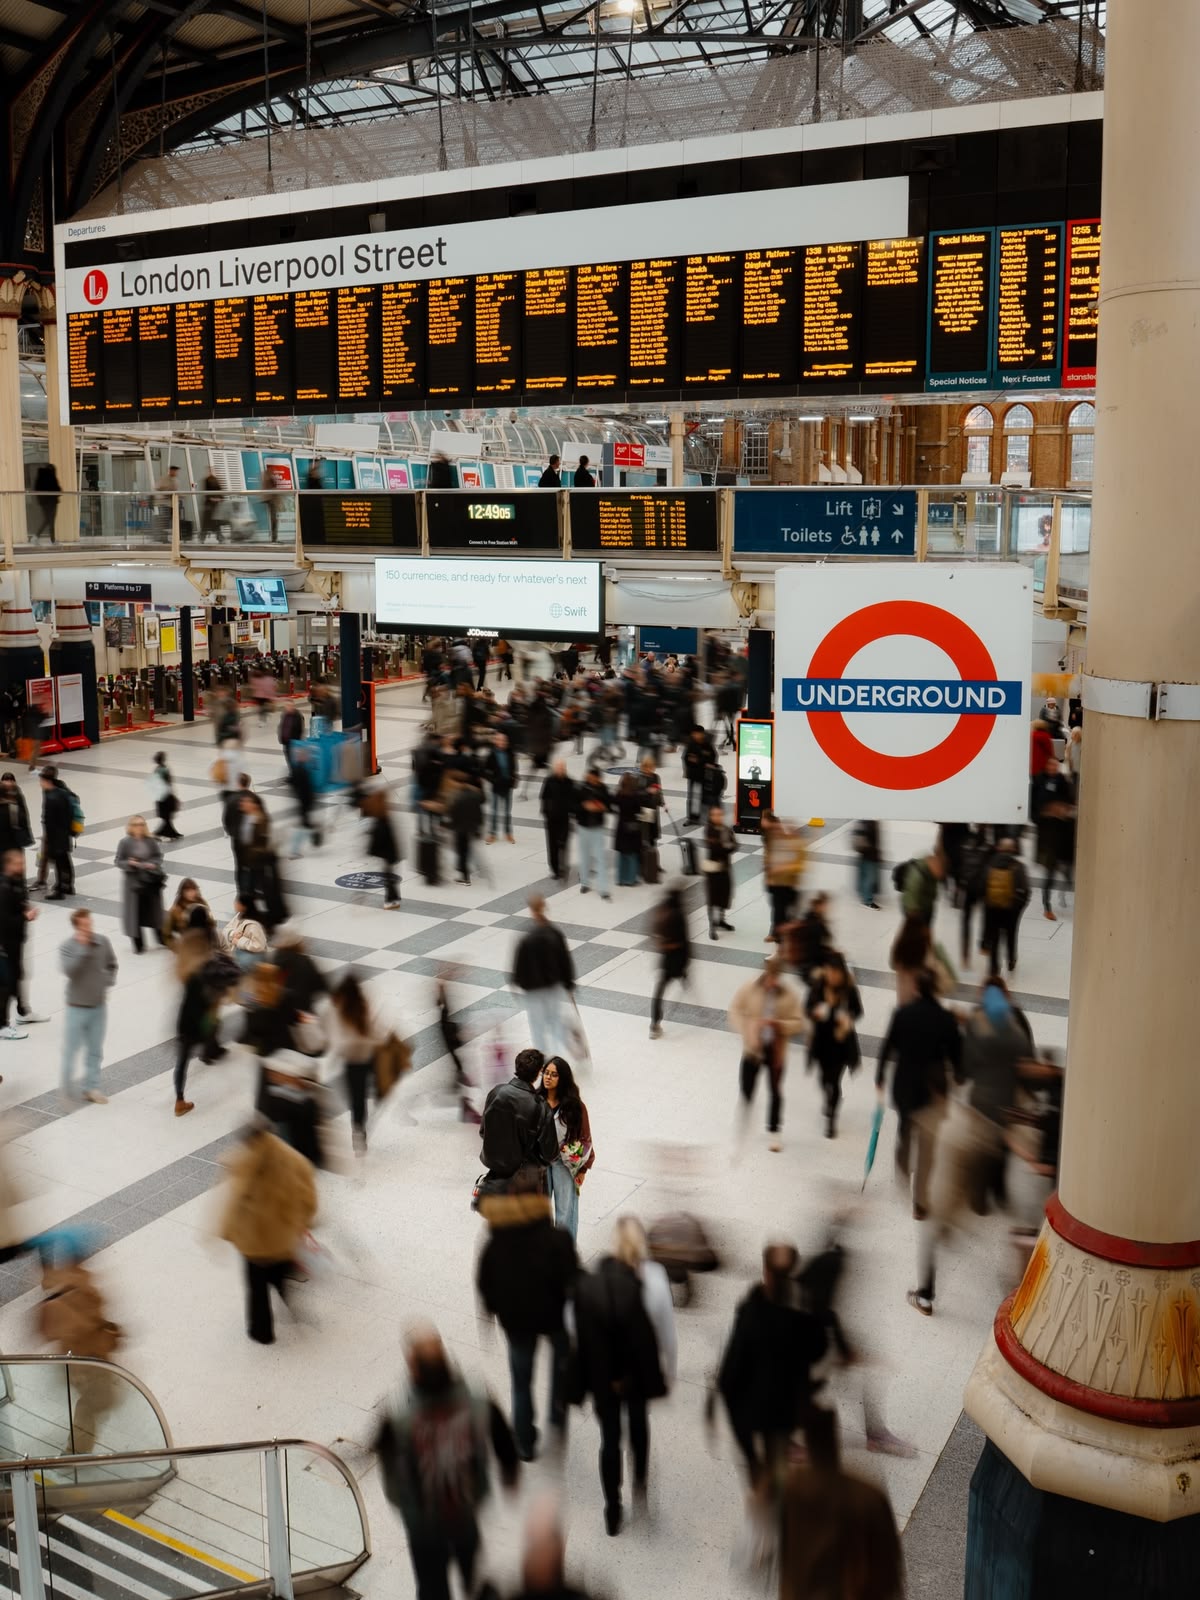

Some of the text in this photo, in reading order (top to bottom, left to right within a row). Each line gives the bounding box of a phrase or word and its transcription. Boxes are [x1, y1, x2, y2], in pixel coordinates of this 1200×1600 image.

[68, 225, 106, 236] Departures
[1073, 226, 1091, 235] 12:55
[939, 234, 985, 245] Special Notices
[828, 245, 852, 254] Platform
[868, 249, 918, 260] Stansted Airport
[707, 255, 730, 263] Platform
[805, 257, 826, 265] Clacton
[120, 264, 210, 297] London
[219, 245, 345, 288] Liverpool
[354, 238, 447, 273] Street
[744, 260, 771, 270] Chingford
[631, 271, 647, 279] Enfield
[1072, 266, 1089, 275] 13:10
[1071, 307, 1088, 315] 13:25
[930, 378, 957, 387] Special
[827, 501, 852, 515] Lift
[781, 528, 832, 542] Toilets
[386, 570, 587, 584] 150 currencies, and ready for whatever's next
[564, 606, 587, 616] Swift
[467, 629, 499, 637] JCDecaux
[797, 685, 1006, 708] UNDERGROUND
